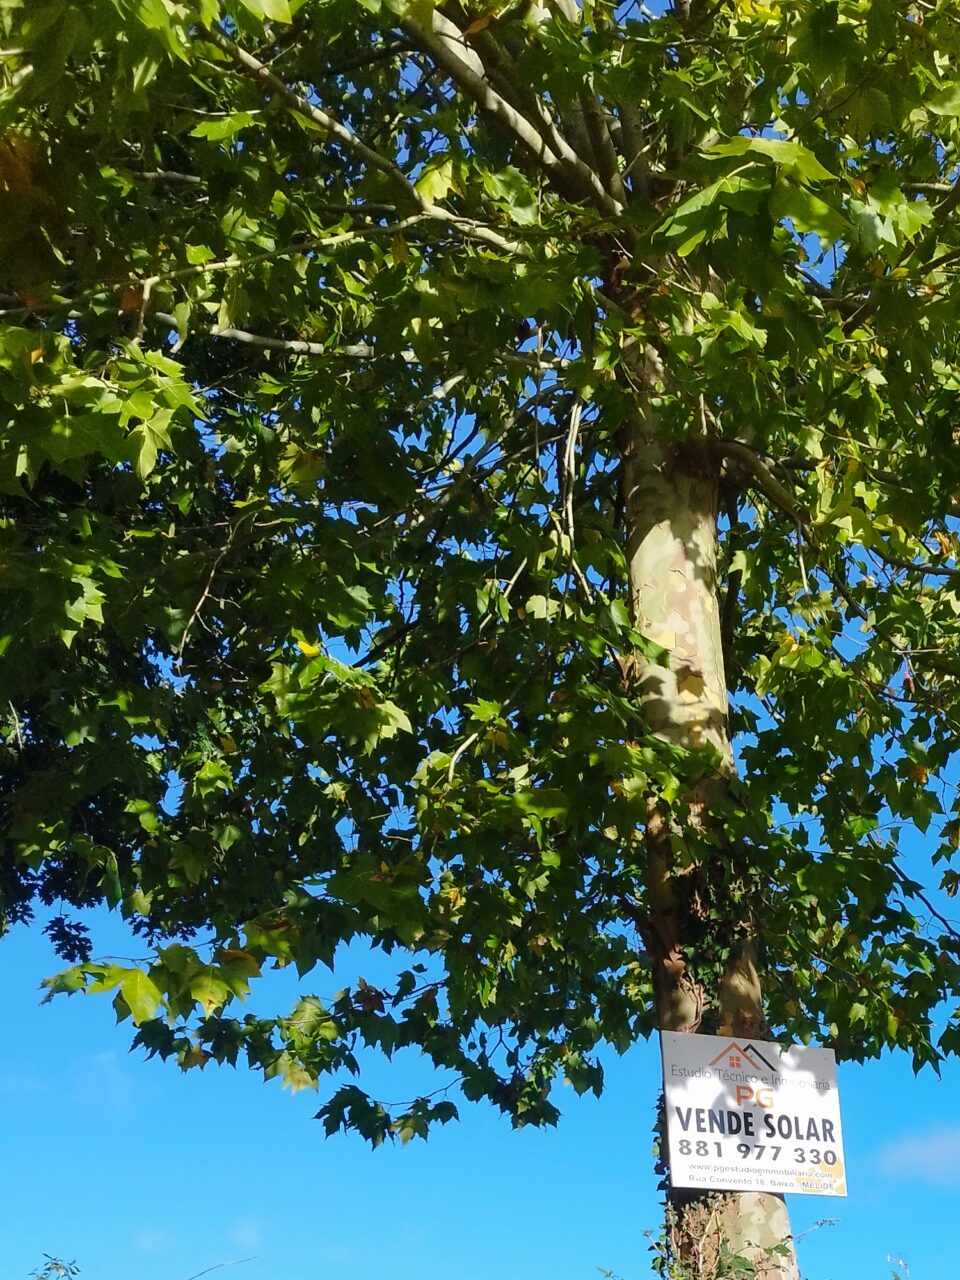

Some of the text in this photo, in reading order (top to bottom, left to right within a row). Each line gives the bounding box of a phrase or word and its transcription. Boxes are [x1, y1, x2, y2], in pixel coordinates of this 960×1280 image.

[671, 1064, 712, 1079] Estudio
[761, 1075, 768, 1084] e
[771, 1073, 830, 1090] Inmiliaria
[735, 1085, 774, 1108] PG
[675, 1106, 836, 1143] VENDE SOLAR
[678, 1139, 837, 1166] 881 977 330
